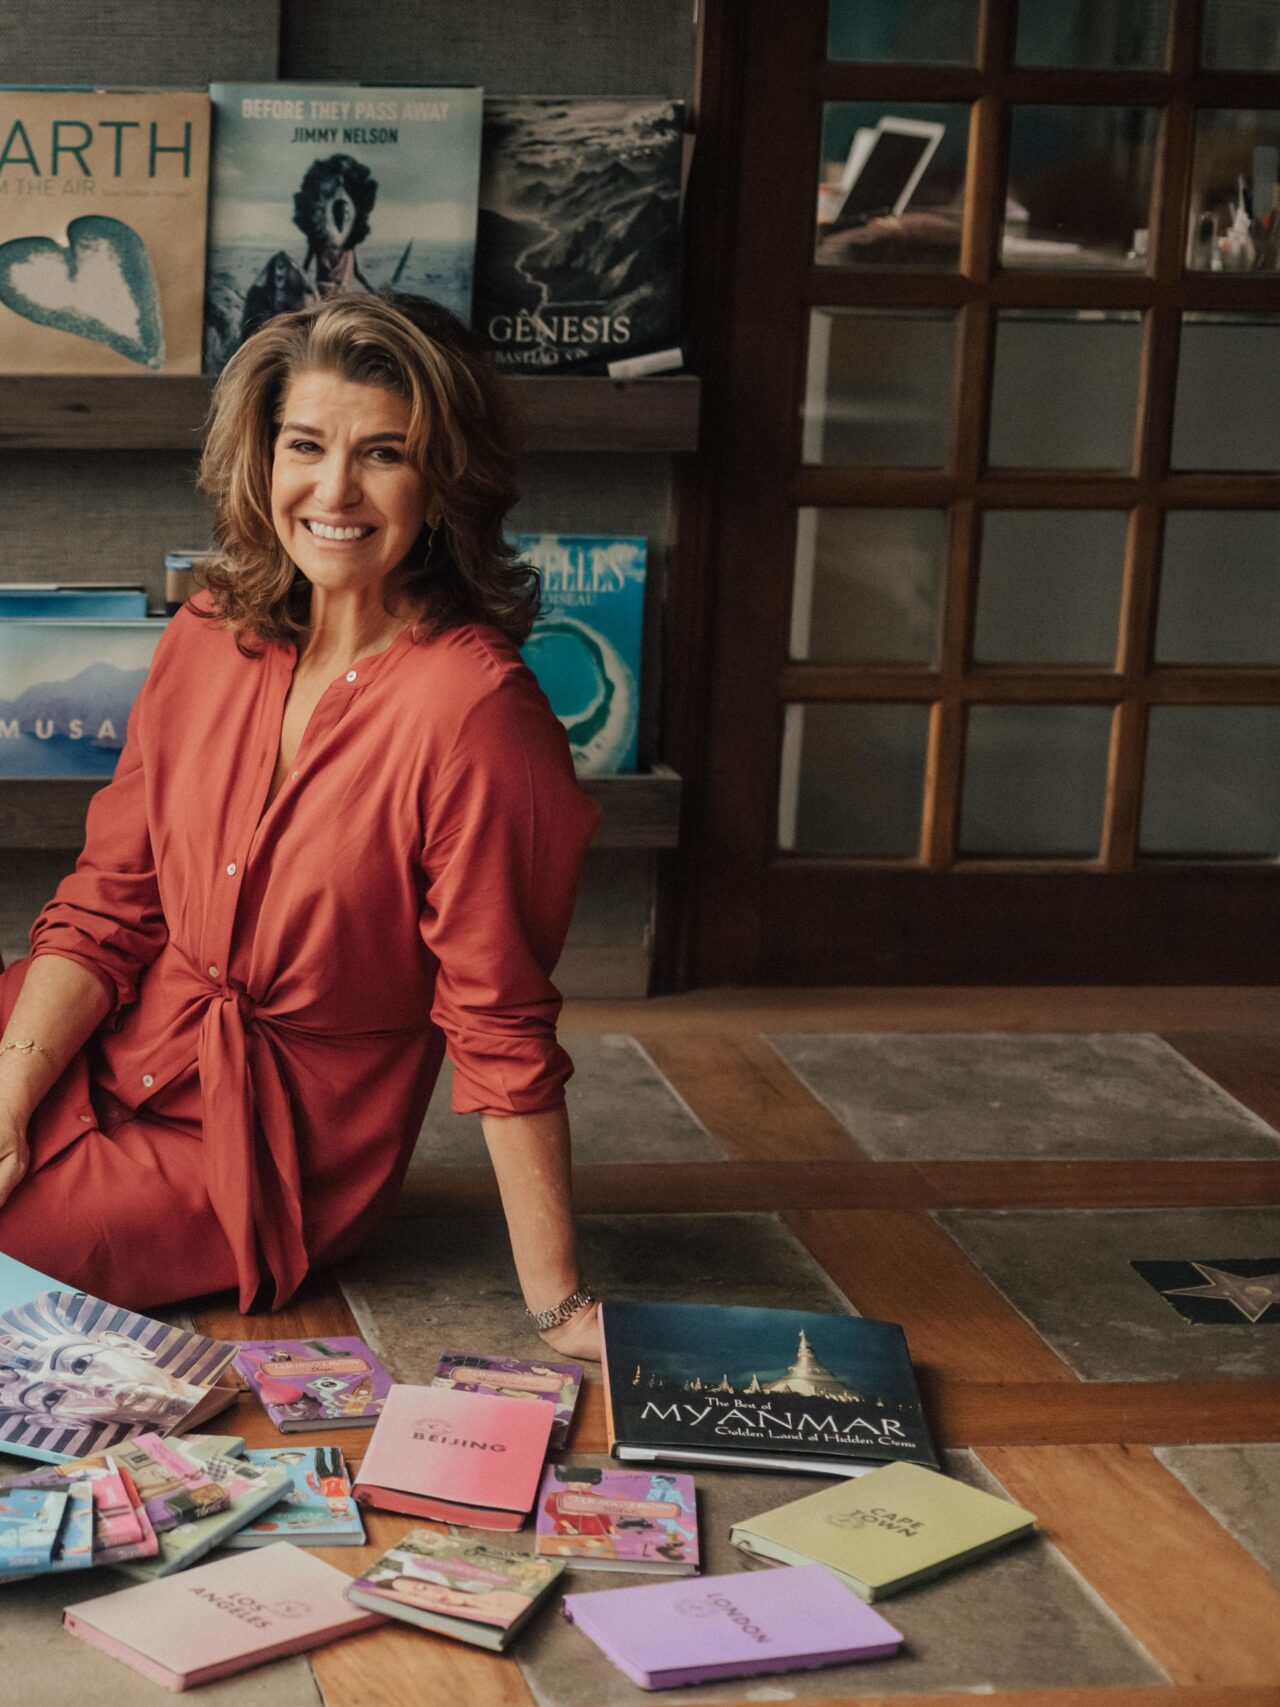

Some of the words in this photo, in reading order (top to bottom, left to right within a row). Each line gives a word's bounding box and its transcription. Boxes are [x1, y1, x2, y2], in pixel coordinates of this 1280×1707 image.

[241, 99, 305, 121] BEFORE
[309, 99, 353, 121] THEY
[357, 101, 398, 121] PASS
[401, 102, 449, 122] AWAY
[291, 127, 338, 144] JIMMY
[342, 127, 399, 144] NELSON
[14, 178, 57, 198] THE
[61, 178, 96, 198] AIR
[488, 308, 632, 344] GÊNESIS
[705, 1396, 730, 1408] The
[734, 1399, 757, 1410] Best
[761, 1401, 773, 1411] of
[640, 1400, 907, 1438] MYANMAR
[412, 1432, 507, 1452] BEIJING
[714, 1426, 764, 1438] Golden
[768, 1429, 804, 1441] Land
[807, 1432, 819, 1442] of
[824, 1432, 874, 1445] Hidden
[878, 1436, 917, 1448] Gems
[850, 1508, 918, 1537] TOWN
[870, 1508, 925, 1529] CAPE
[188, 1587, 273, 1629] ANGELES
[227, 1591, 269, 1612] LOS
[706, 1592, 774, 1644] LONDON
